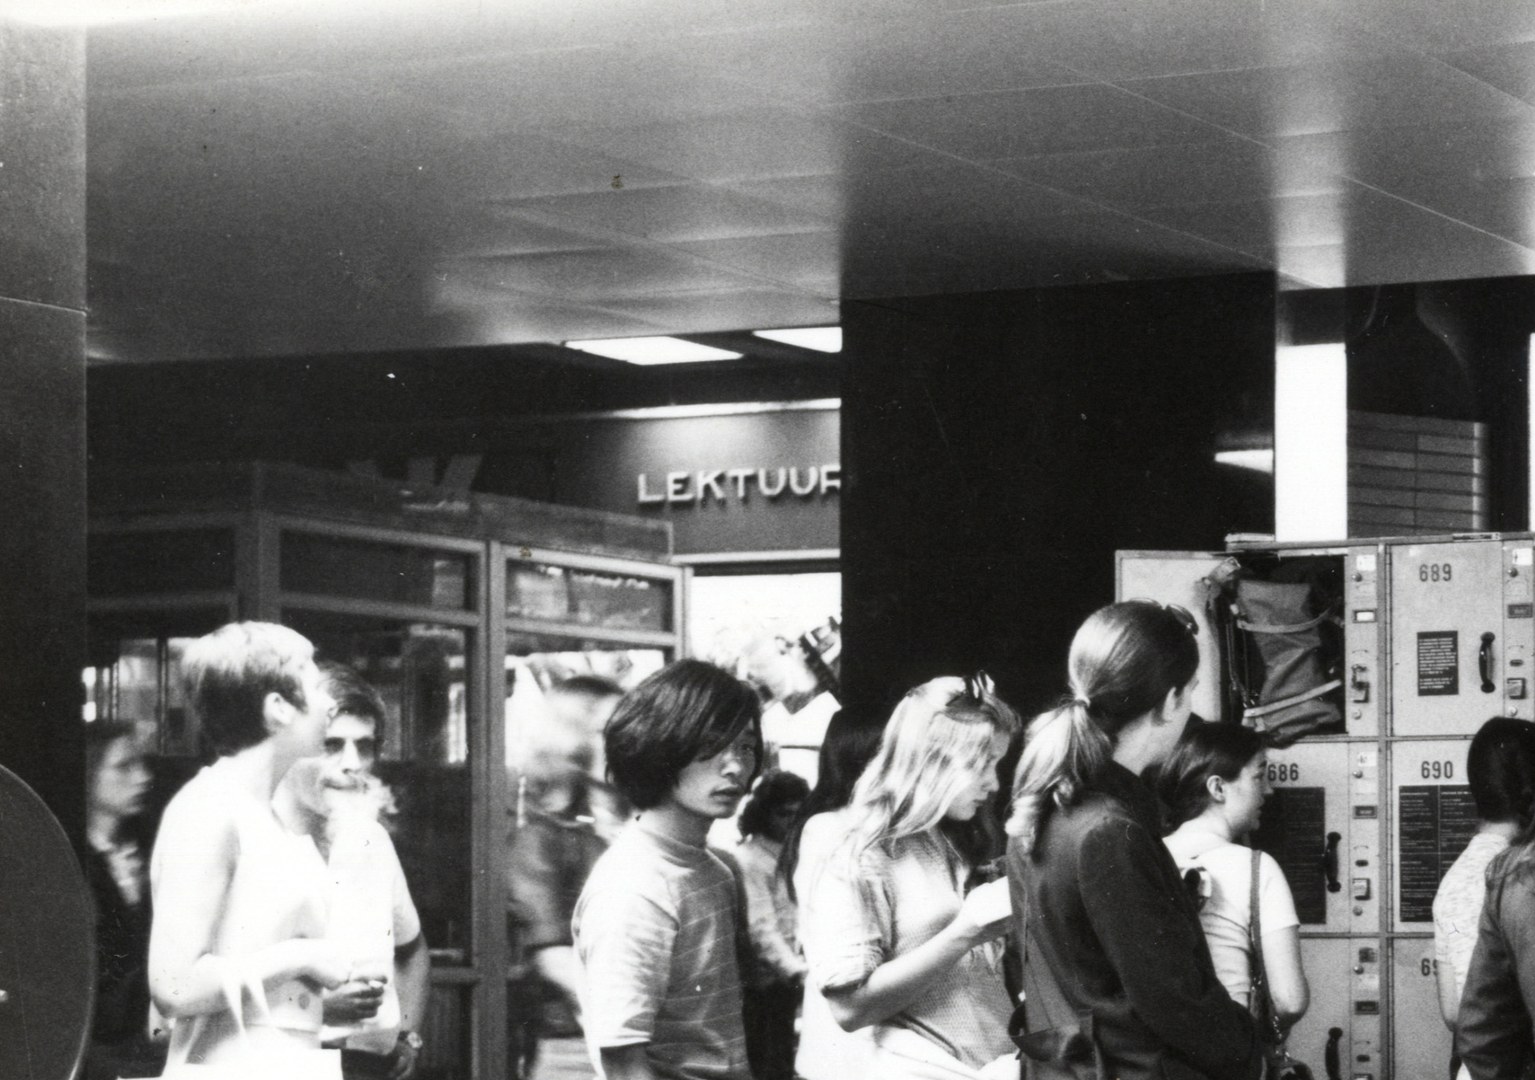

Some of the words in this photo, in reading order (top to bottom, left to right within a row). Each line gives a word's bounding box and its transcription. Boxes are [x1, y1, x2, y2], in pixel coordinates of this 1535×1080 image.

[1419, 563, 1452, 583] 689
[1268, 763, 1299, 781] 686
[1421, 760, 1453, 779] 690
